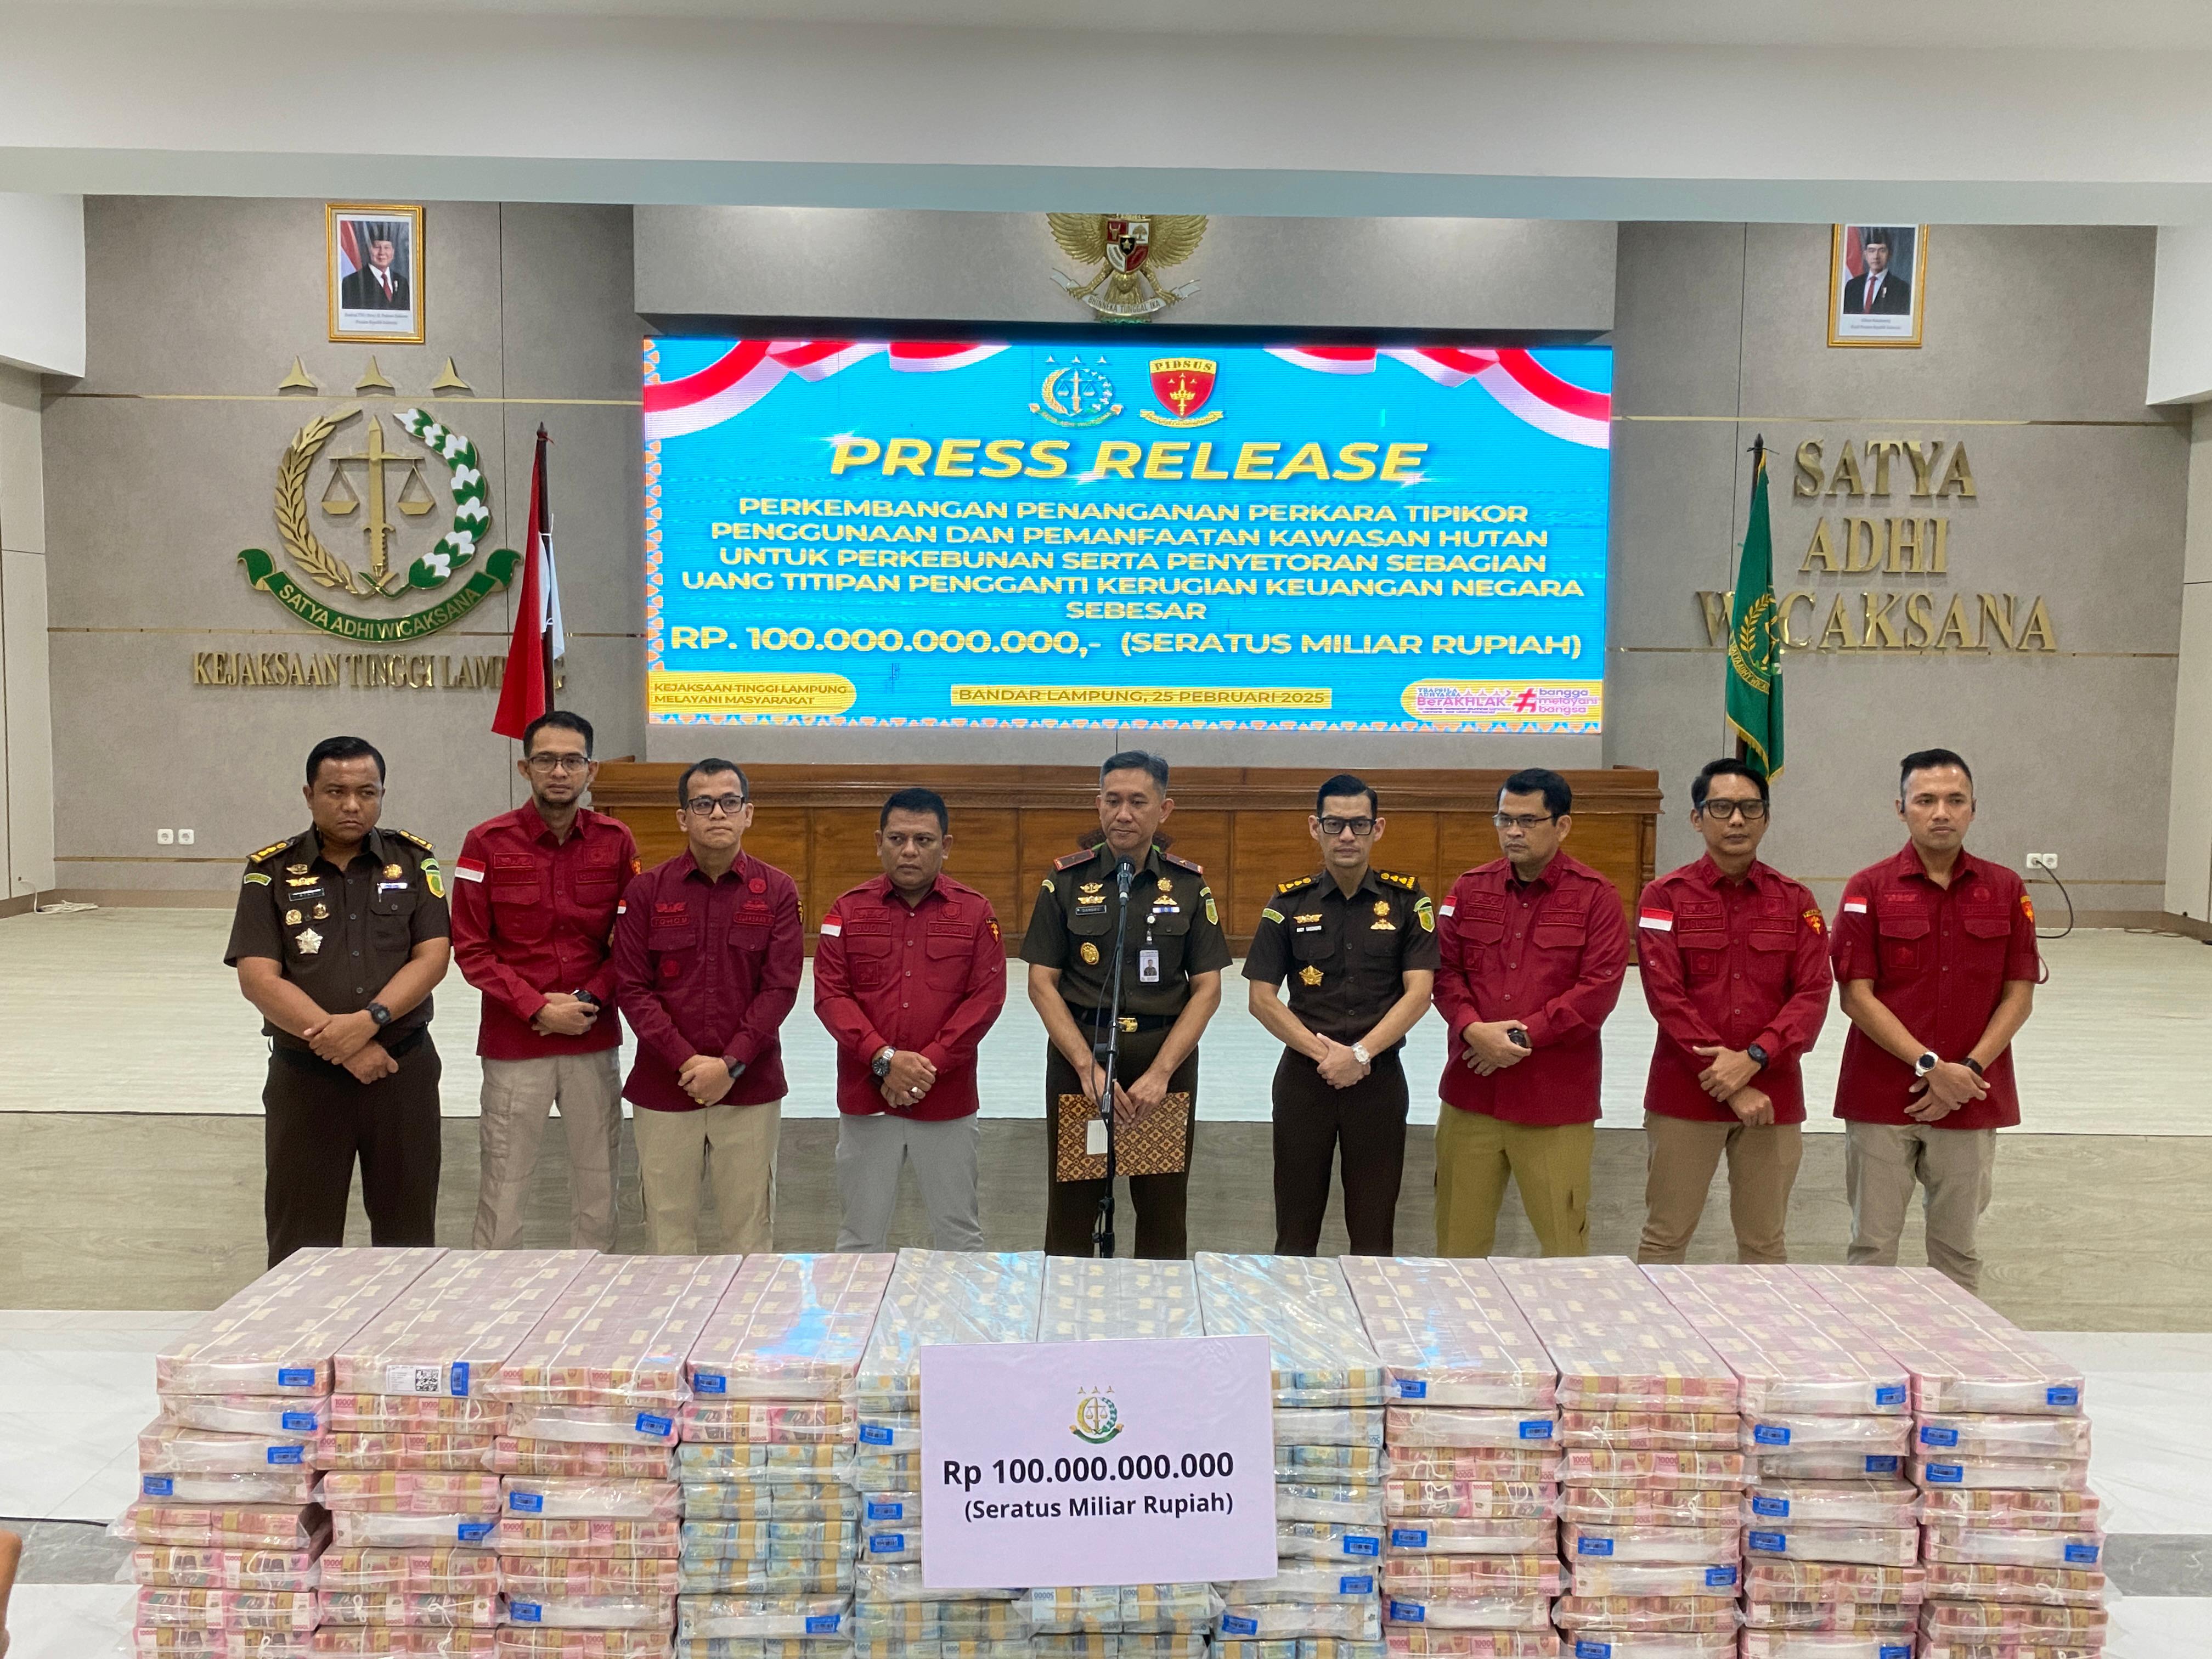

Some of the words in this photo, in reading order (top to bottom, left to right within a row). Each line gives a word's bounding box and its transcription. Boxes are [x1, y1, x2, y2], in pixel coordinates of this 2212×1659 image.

[1120, 303, 1148, 313] TUNGGAL
[1154, 360, 1212, 371] PIDSUS
[829, 438, 1070, 478] PRESS
[1092, 441, 1429, 481] RELEASE
[1794, 439, 1977, 497] SATYA
[740, 498, 1008, 519] PERKEMBANGAN
[1018, 501, 1239, 521] PENANGANAN
[1249, 504, 1397, 522] PERKARA
[1406, 505, 1528, 523] TIPIKOR
[712, 522, 937, 543] PENGGUNAAN
[946, 526, 1014, 544] DAN
[1023, 527, 1260, 546] PEMANFAATAN
[1269, 529, 1430, 547] KAWASAN
[1439, 530, 1548, 548] HUTAN
[1799, 516, 1949, 573] ADHI
[719, 548, 828, 567] UNTUK
[838, 549, 1054, 569] PERKEBUNAN
[1062, 552, 1159, 570] SERTA
[1167, 553, 1378, 571] PENYETORAN
[1386, 554, 1545, 572] SEBAGIAN
[682, 572, 774, 590] UANG
[781, 573, 900, 591] TITIPAN
[909, 575, 1088, 594] PENGGANTI
[1097, 577, 1257, 595] KERUGIAN
[1266, 579, 1443, 596] KEUANGAN
[1452, 579, 1584, 597] NEGARA
[279, 584, 329, 628] SATYA
[330, 616, 374, 639] ADHI
[378, 587, 481, 639] WICAKSANA
[1066, 602, 1206, 620] SEBESAR
[1695, 590, 2057, 651] WCAKSANA
[671, 626, 737, 650] RP.
[750, 627, 1101, 658] 100.000.000.000,-
[1122, 631, 1292, 656] (SERATUS
[1301, 635, 1423, 654] MILIAR
[1432, 635, 1581, 659] RUPIAH)
[194, 651, 337, 686] KEJAKSAAN
[345, 652, 437, 688] TINGGI
[653, 684, 732, 692] KEJAKSAAN
[736, 685, 778, 693] TINGGI
[781, 685, 847, 694] LAMPUNG
[654, 695, 722, 703] MELAYANI
[725, 696, 815, 704] MASYARAKAT
[959, 689, 1041, 701] BANDAR
[1047, 690, 1148, 703] LAMPUNG,
[1153, 691, 1173, 702] 25
[1180, 691, 1275, 703] PEBRUARI
[1281, 692, 1324, 703] 2025
[1538, 688, 1589, 698] bangga
[1538, 697, 1598, 706] melayani
[1417, 697, 1506, 707] BerAKHLAK
[1538, 706, 1587, 715] bangsa
[944, 1460, 981, 1492] Rp
[992, 1452, 1234, 1483] 100.000.000.000
[964, 1499, 1061, 1522] (Seratus
[1069, 1496, 1136, 1517] Miliar
[1144, 1492, 1233, 1519] Rupiah)
